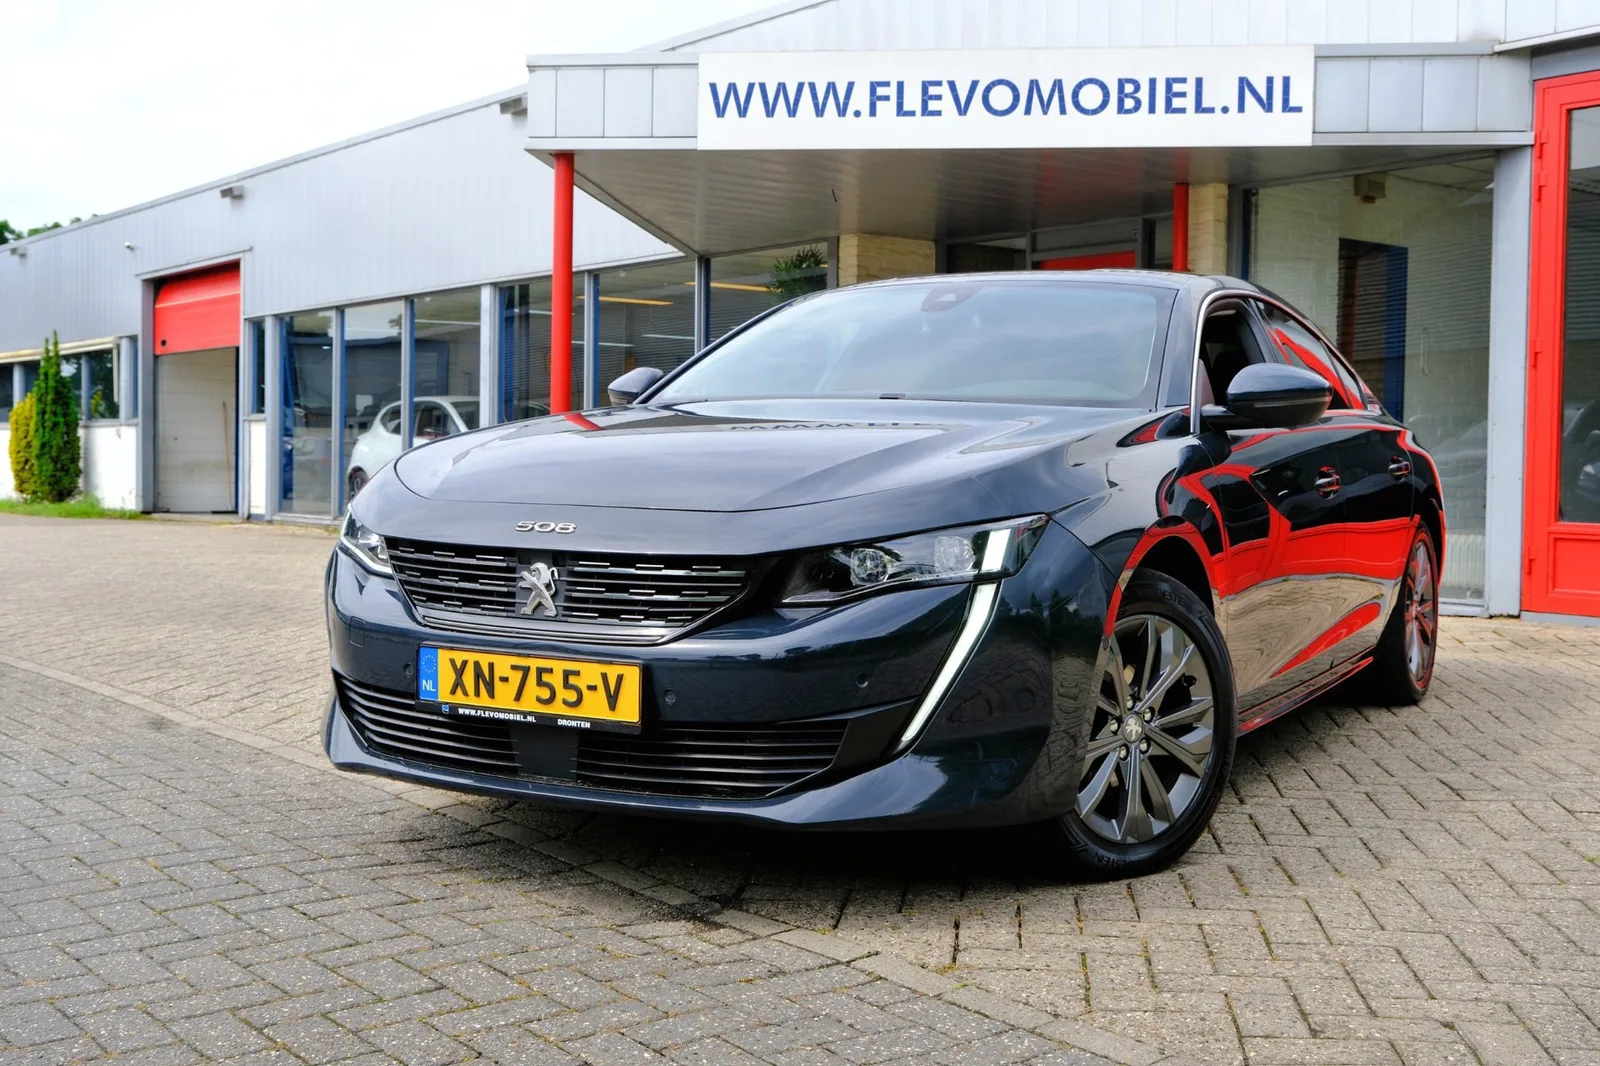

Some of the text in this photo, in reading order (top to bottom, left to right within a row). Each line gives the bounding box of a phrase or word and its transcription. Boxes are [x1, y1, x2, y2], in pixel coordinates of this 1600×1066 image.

[708, 75, 1304, 119] WWW.FLEVOMOBIEL.NL
[515, 521, 577, 534] 508
[422, 680, 436, 692] NL
[448, 657, 625, 712] XN-755-V
[458, 707, 591, 729] WWW.FLEVOMOBIEL.NL DRONTEN
